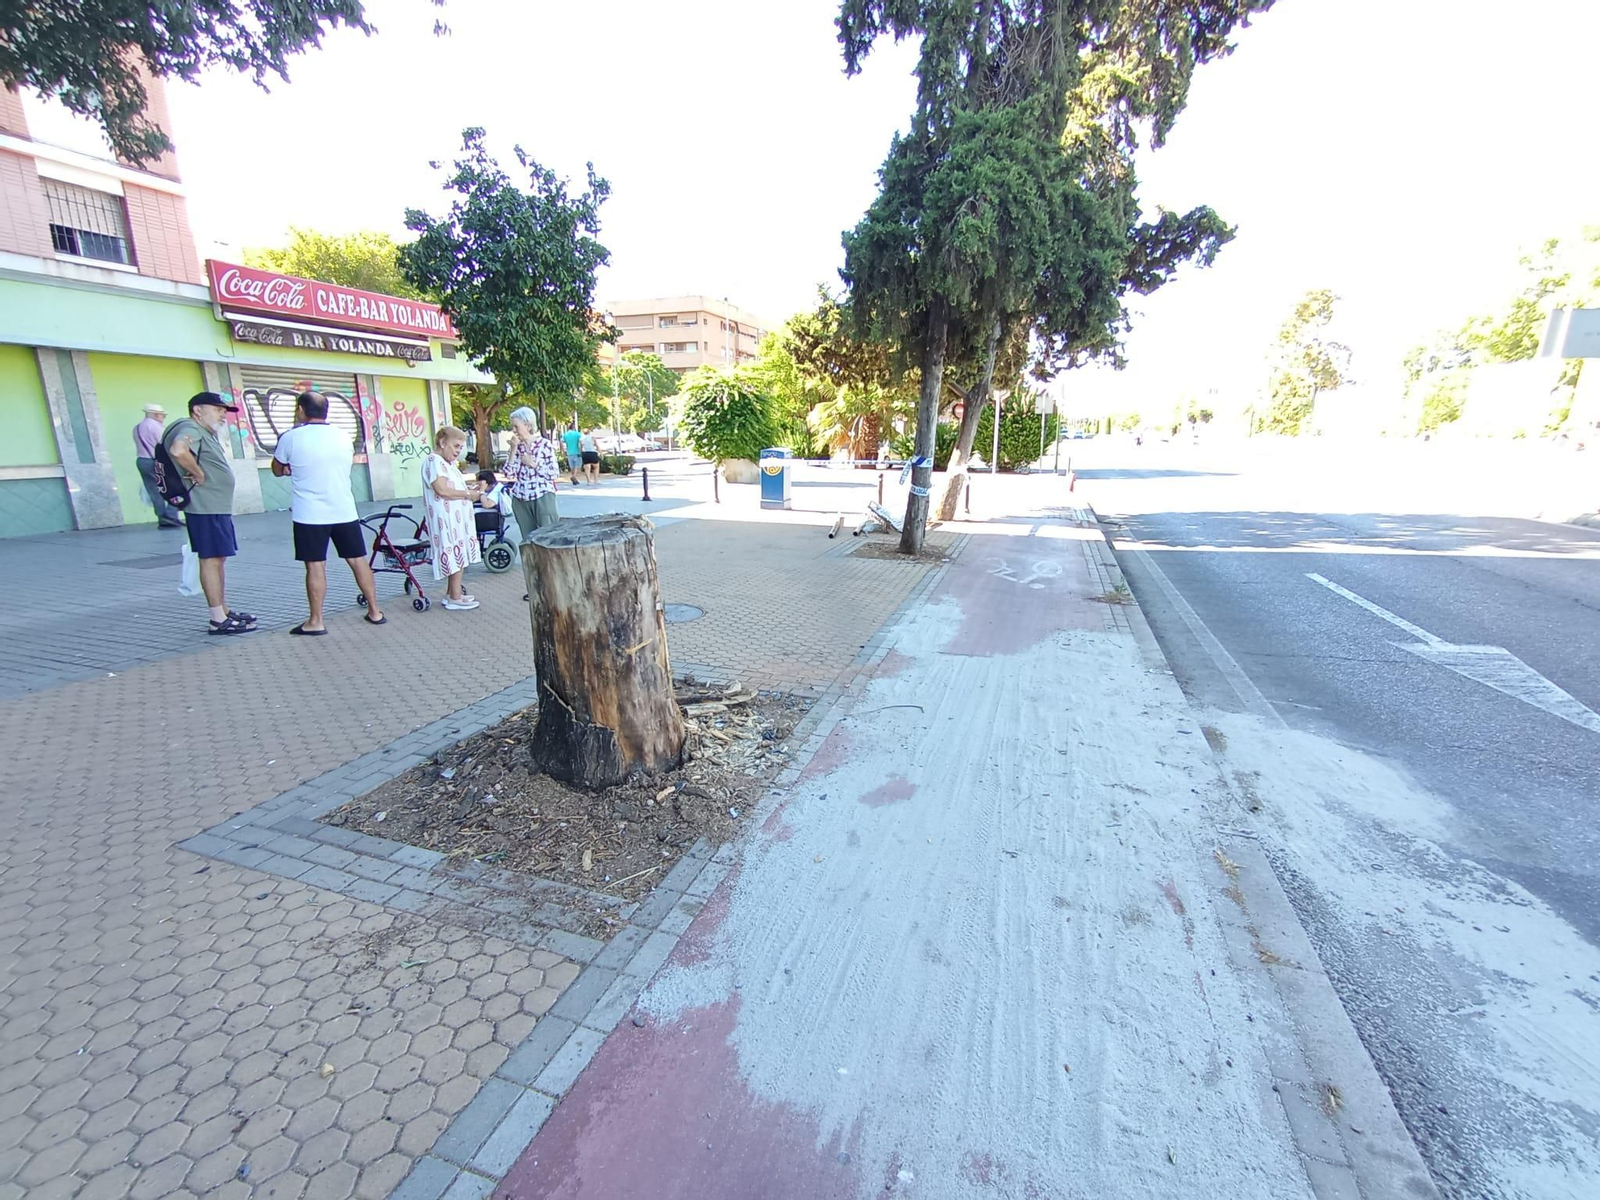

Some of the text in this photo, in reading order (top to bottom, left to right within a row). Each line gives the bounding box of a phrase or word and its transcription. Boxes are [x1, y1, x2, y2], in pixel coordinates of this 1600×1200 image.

[219, 269, 307, 310] Coca-Cola
[316, 289, 448, 332] CAFE-BAR YOLANDA
[292, 332, 395, 357] BAR YOLANDA
